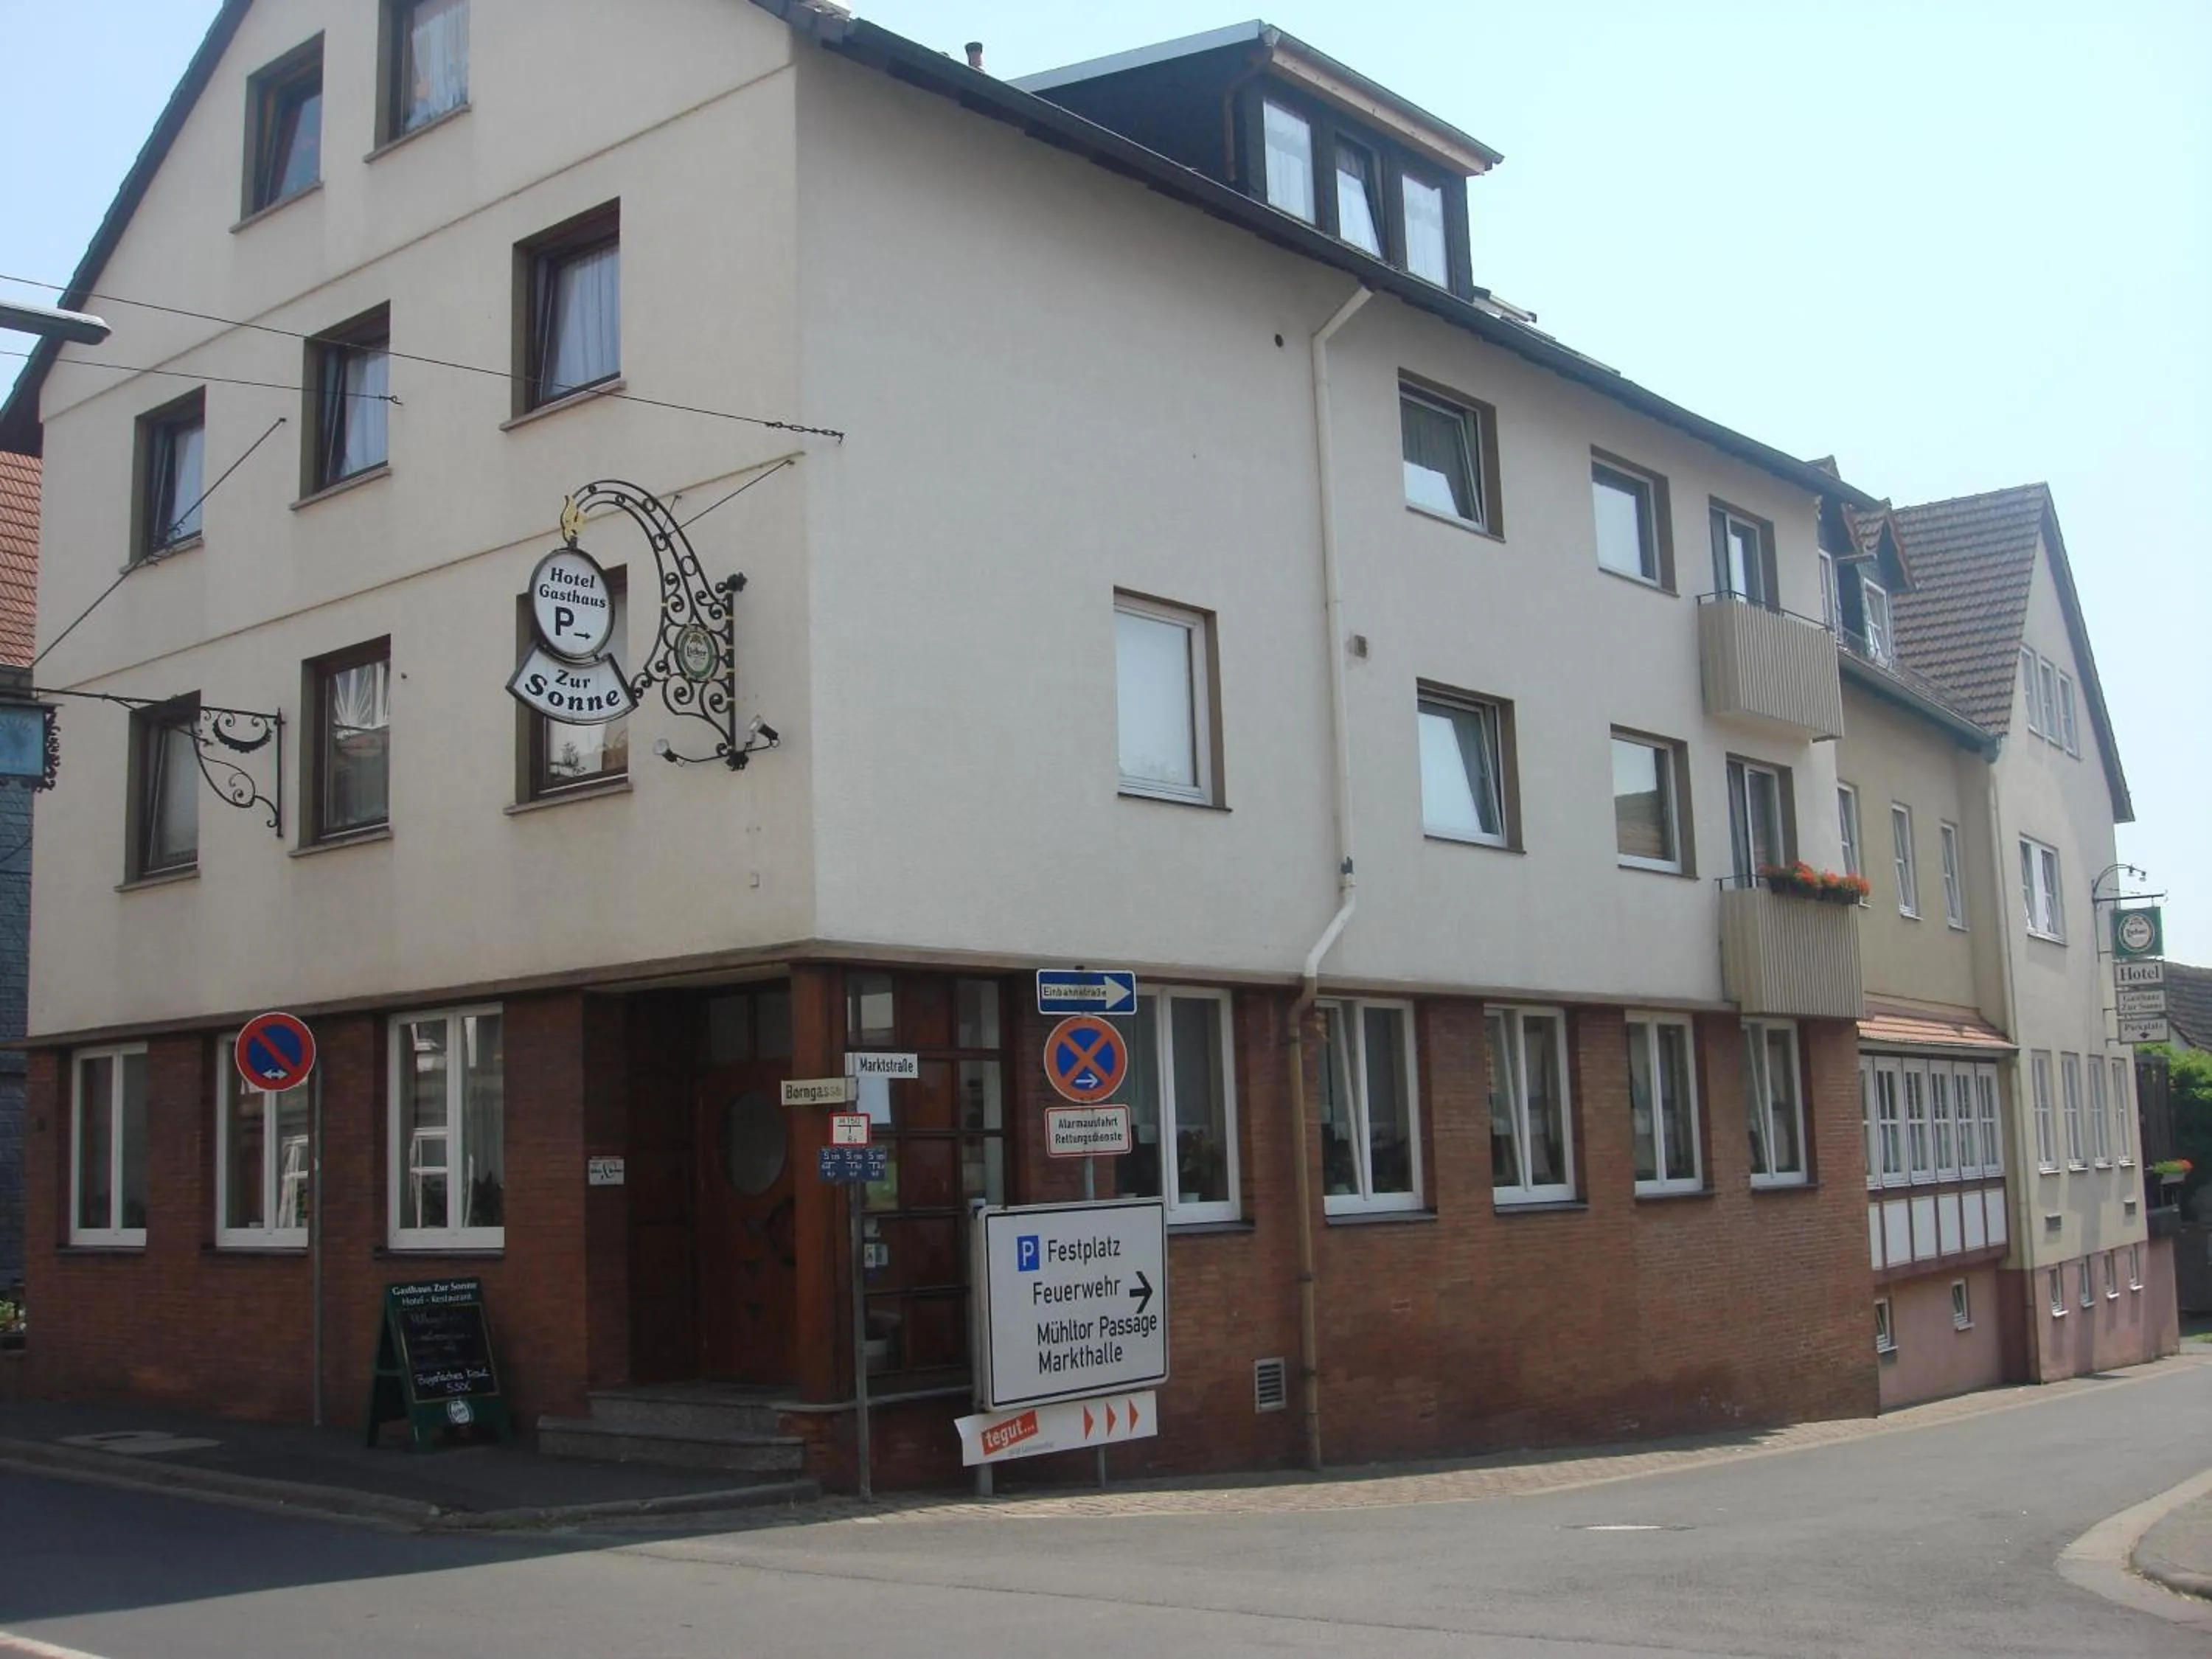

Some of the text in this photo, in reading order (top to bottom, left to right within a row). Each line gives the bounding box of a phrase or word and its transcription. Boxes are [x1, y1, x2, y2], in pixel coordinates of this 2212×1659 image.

[550, 567, 595, 588] Hotel
[539, 584, 606, 608] Gasthaus
[554, 606, 574, 636] P
[555, 669, 591, 689] Zur
[524, 672, 620, 712] Sonne
[2121, 965, 2160, 981] Hotel
[1043, 986, 1107, 996] Einbahnstraße
[860, 1057, 914, 1073] Marktstraße
[785, 1085, 843, 1101] Borngasse
[1058, 1116, 1119, 1129] Alarmausfahrt
[1022, 1237, 1121, 1267] P Festplatz
[433, 1283, 448, 1292] Zur
[1033, 1276, 1121, 1305] Feuerwehr
[402, 1295, 424, 1305] Hotel
[1037, 1312, 1157, 1346] Mühltor Passage
[1038, 1342, 1123, 1374] Markthalle
